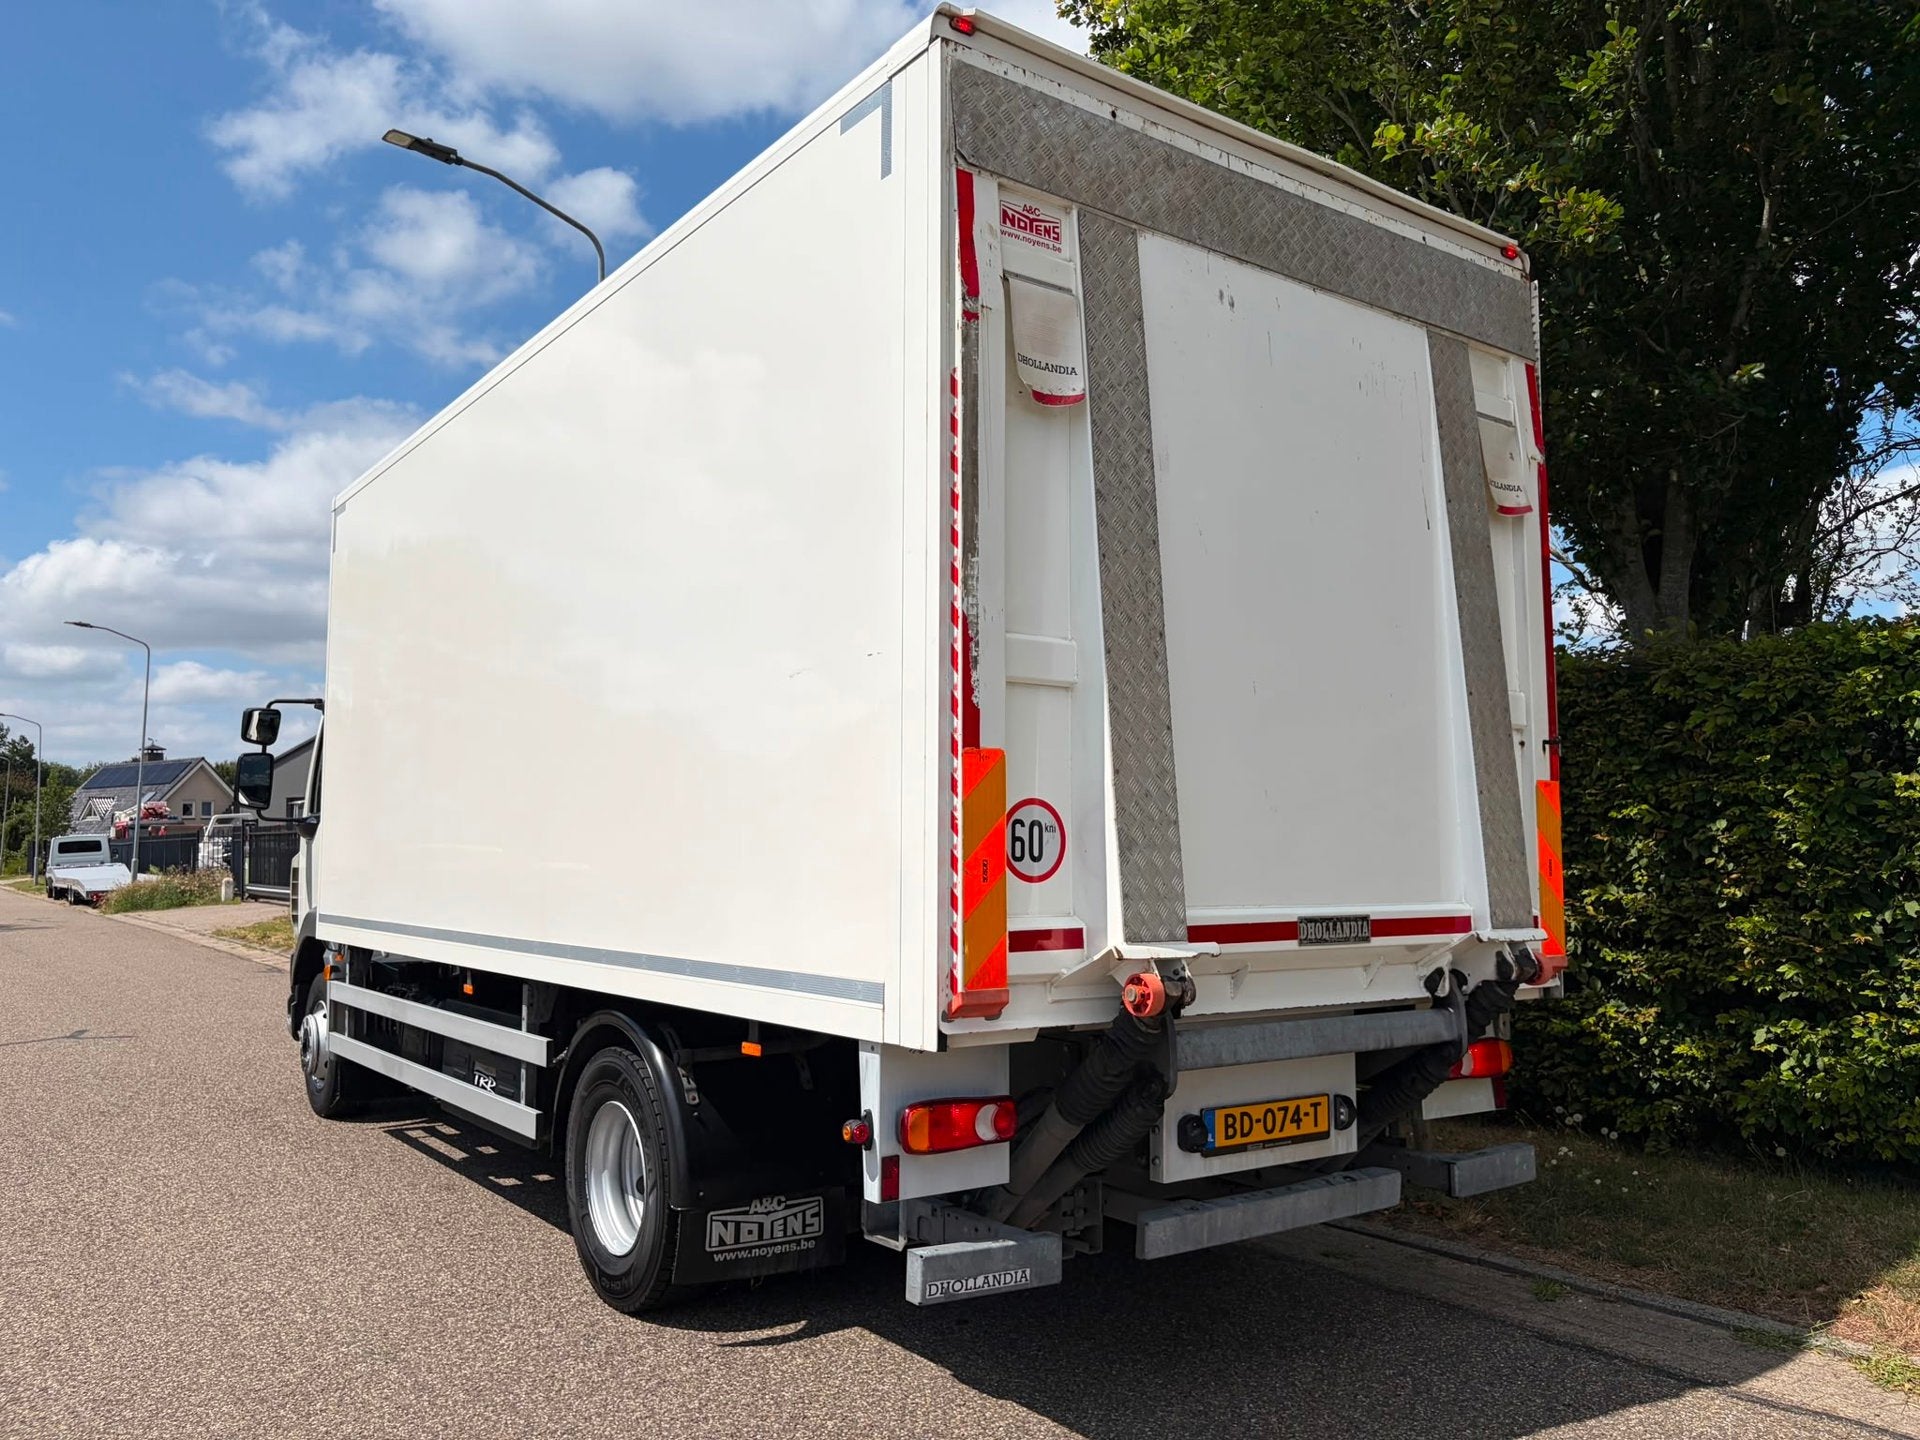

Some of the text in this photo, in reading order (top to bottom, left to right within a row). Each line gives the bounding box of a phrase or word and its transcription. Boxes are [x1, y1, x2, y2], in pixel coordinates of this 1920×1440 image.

[1022, 203, 1041, 217] A&C
[1001, 203, 1060, 242] NOYENS
[1000, 229, 1062, 253] www.noyens.be
[1017, 352, 1078, 376] DHOLLANDIA
[1011, 818, 1043, 863] 60
[1300, 920, 1369, 940] DHOLLANDIA
[474, 1071, 496, 1095] TRP
[1224, 1102, 1322, 1140] BD-074-T
[749, 1195, 786, 1214] A&C
[711, 1201, 820, 1247] NOYENS
[713, 1239, 816, 1262] www.noyens.be
[927, 1269, 1030, 1297] DHOLLANDIA
